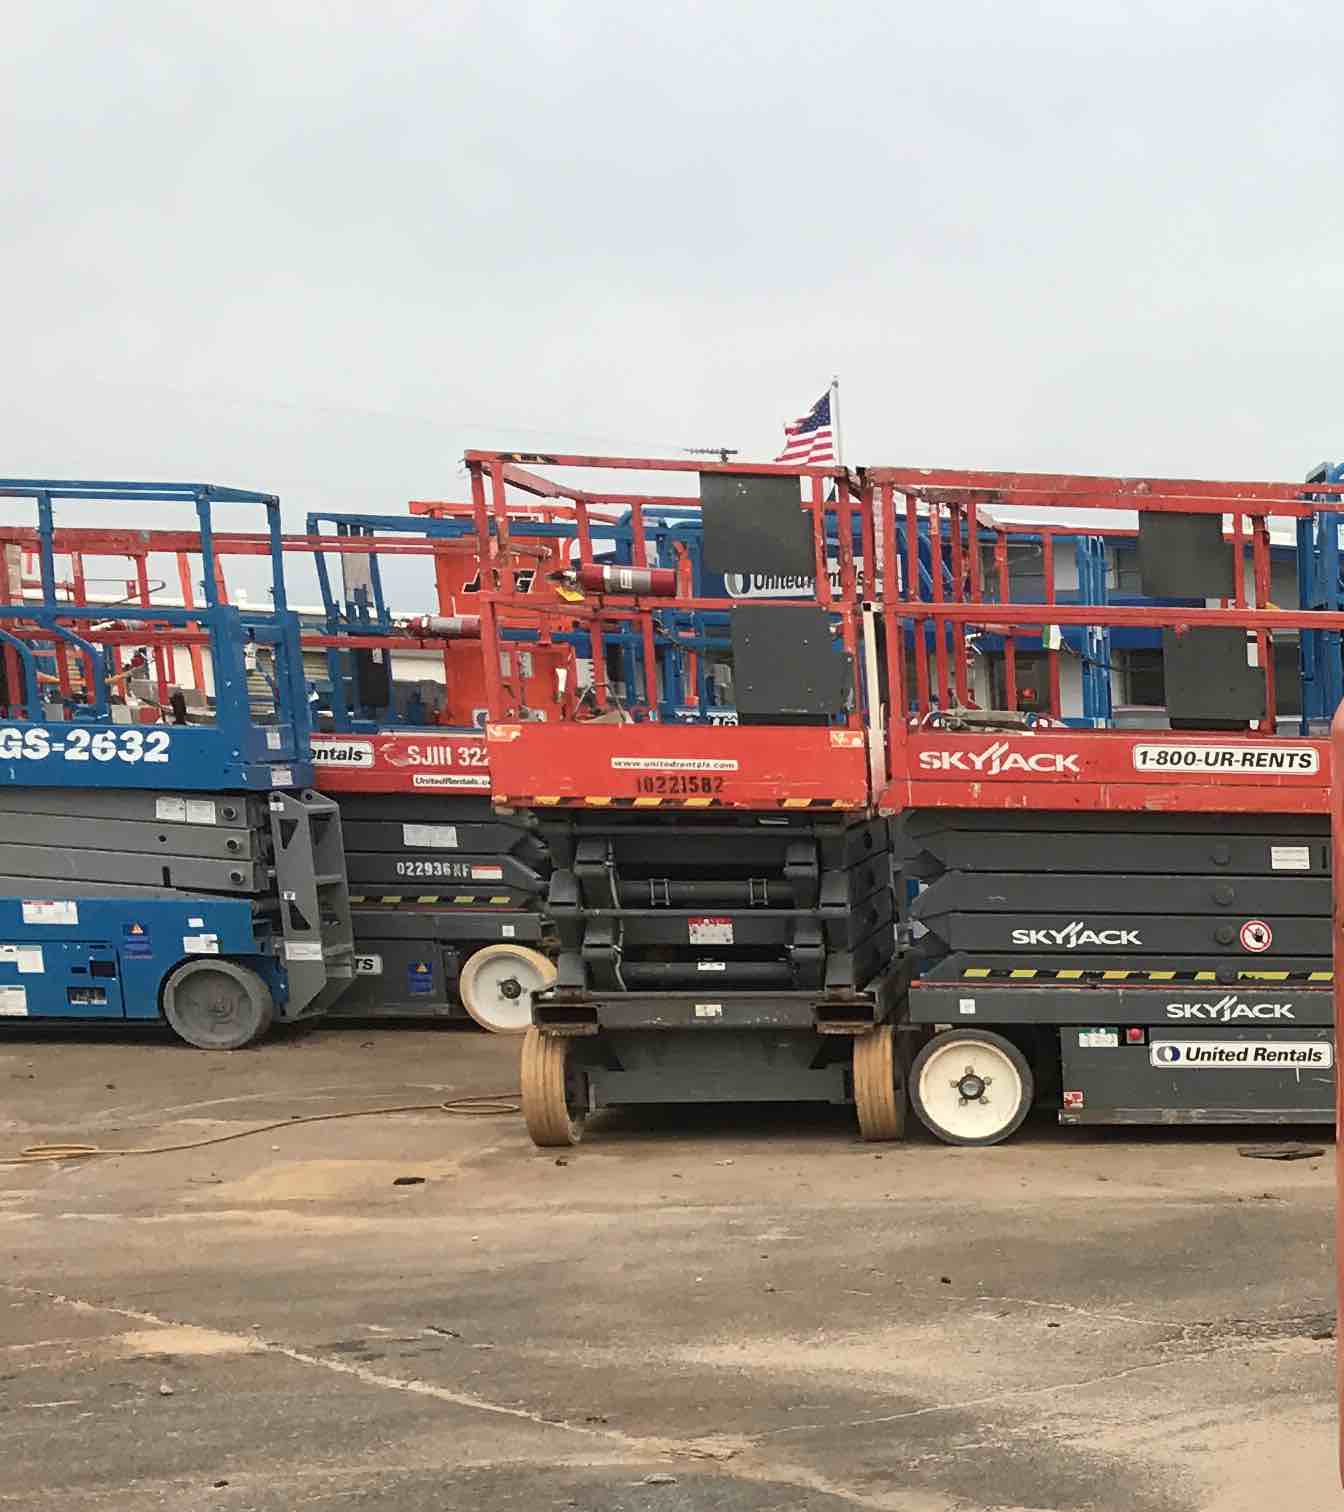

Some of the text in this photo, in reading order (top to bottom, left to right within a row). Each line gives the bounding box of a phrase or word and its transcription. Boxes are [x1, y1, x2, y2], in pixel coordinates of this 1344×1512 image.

[0, 728, 170, 763] GS-2632
[919, 741, 1081, 775] SKYJACK
[1138, 749, 1313, 769] 1-800-UR-RENTS
[1012, 921, 1142, 948] SKYJACK
[1166, 996, 1295, 1021] SKYJACK
[1185, 1046, 1323, 1063] United Rentals
